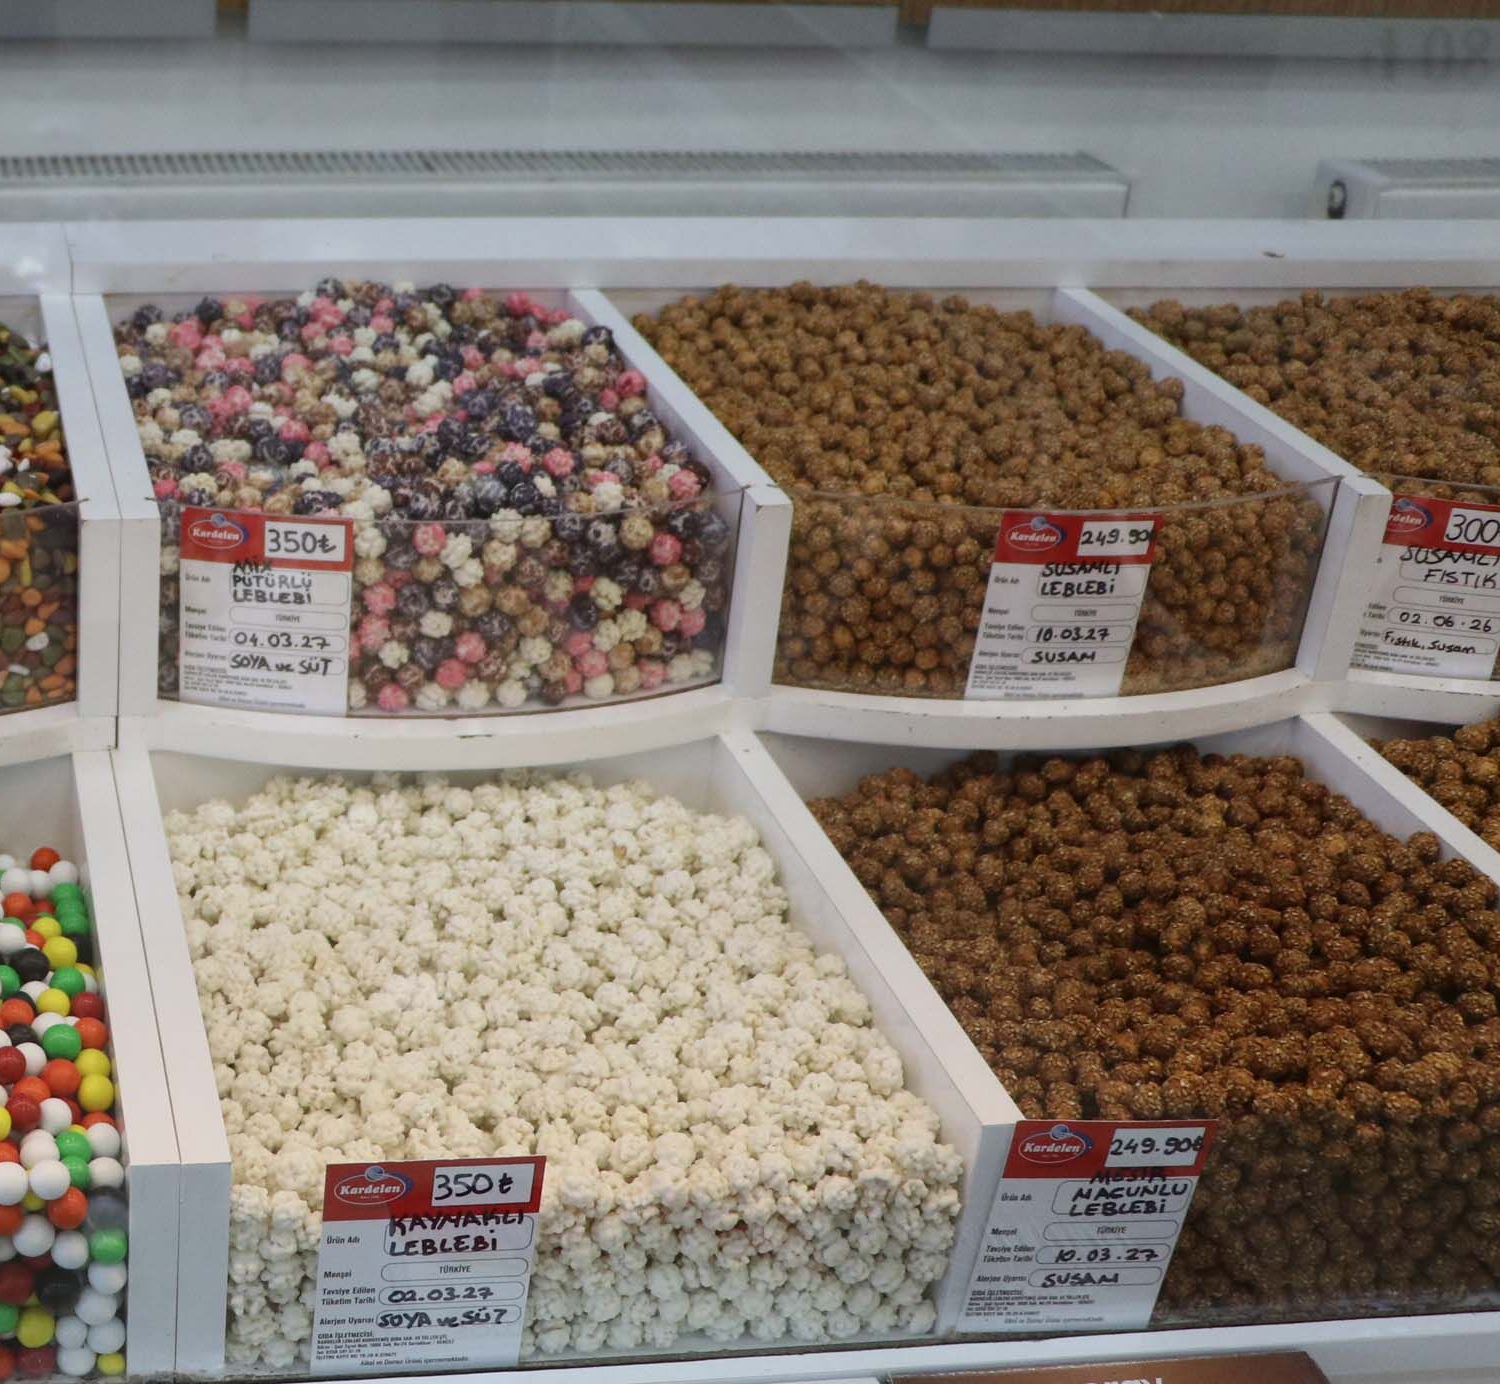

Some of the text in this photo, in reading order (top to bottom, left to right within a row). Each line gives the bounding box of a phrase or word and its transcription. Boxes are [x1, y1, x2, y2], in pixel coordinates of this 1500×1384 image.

[192, 527, 240, 541] Kardelen
[1010, 530, 1057, 543] Kardelen
[1446, 514, 1500, 543] 300
[1423, 569, 1498, 589] FISTIK
[234, 632, 331, 649] 04.03.27
[230, 654, 270, 672] SOYA
[299, 656, 333, 676] SÜT
[1031, 651, 1096, 664] SUSAM
[1022, 1142, 1081, 1153] Kardelen
[339, 1183, 401, 1196] Kardelen
[1041, 1272, 1120, 1288] SUSAM
[378, 1311, 431, 1329] SOYA
